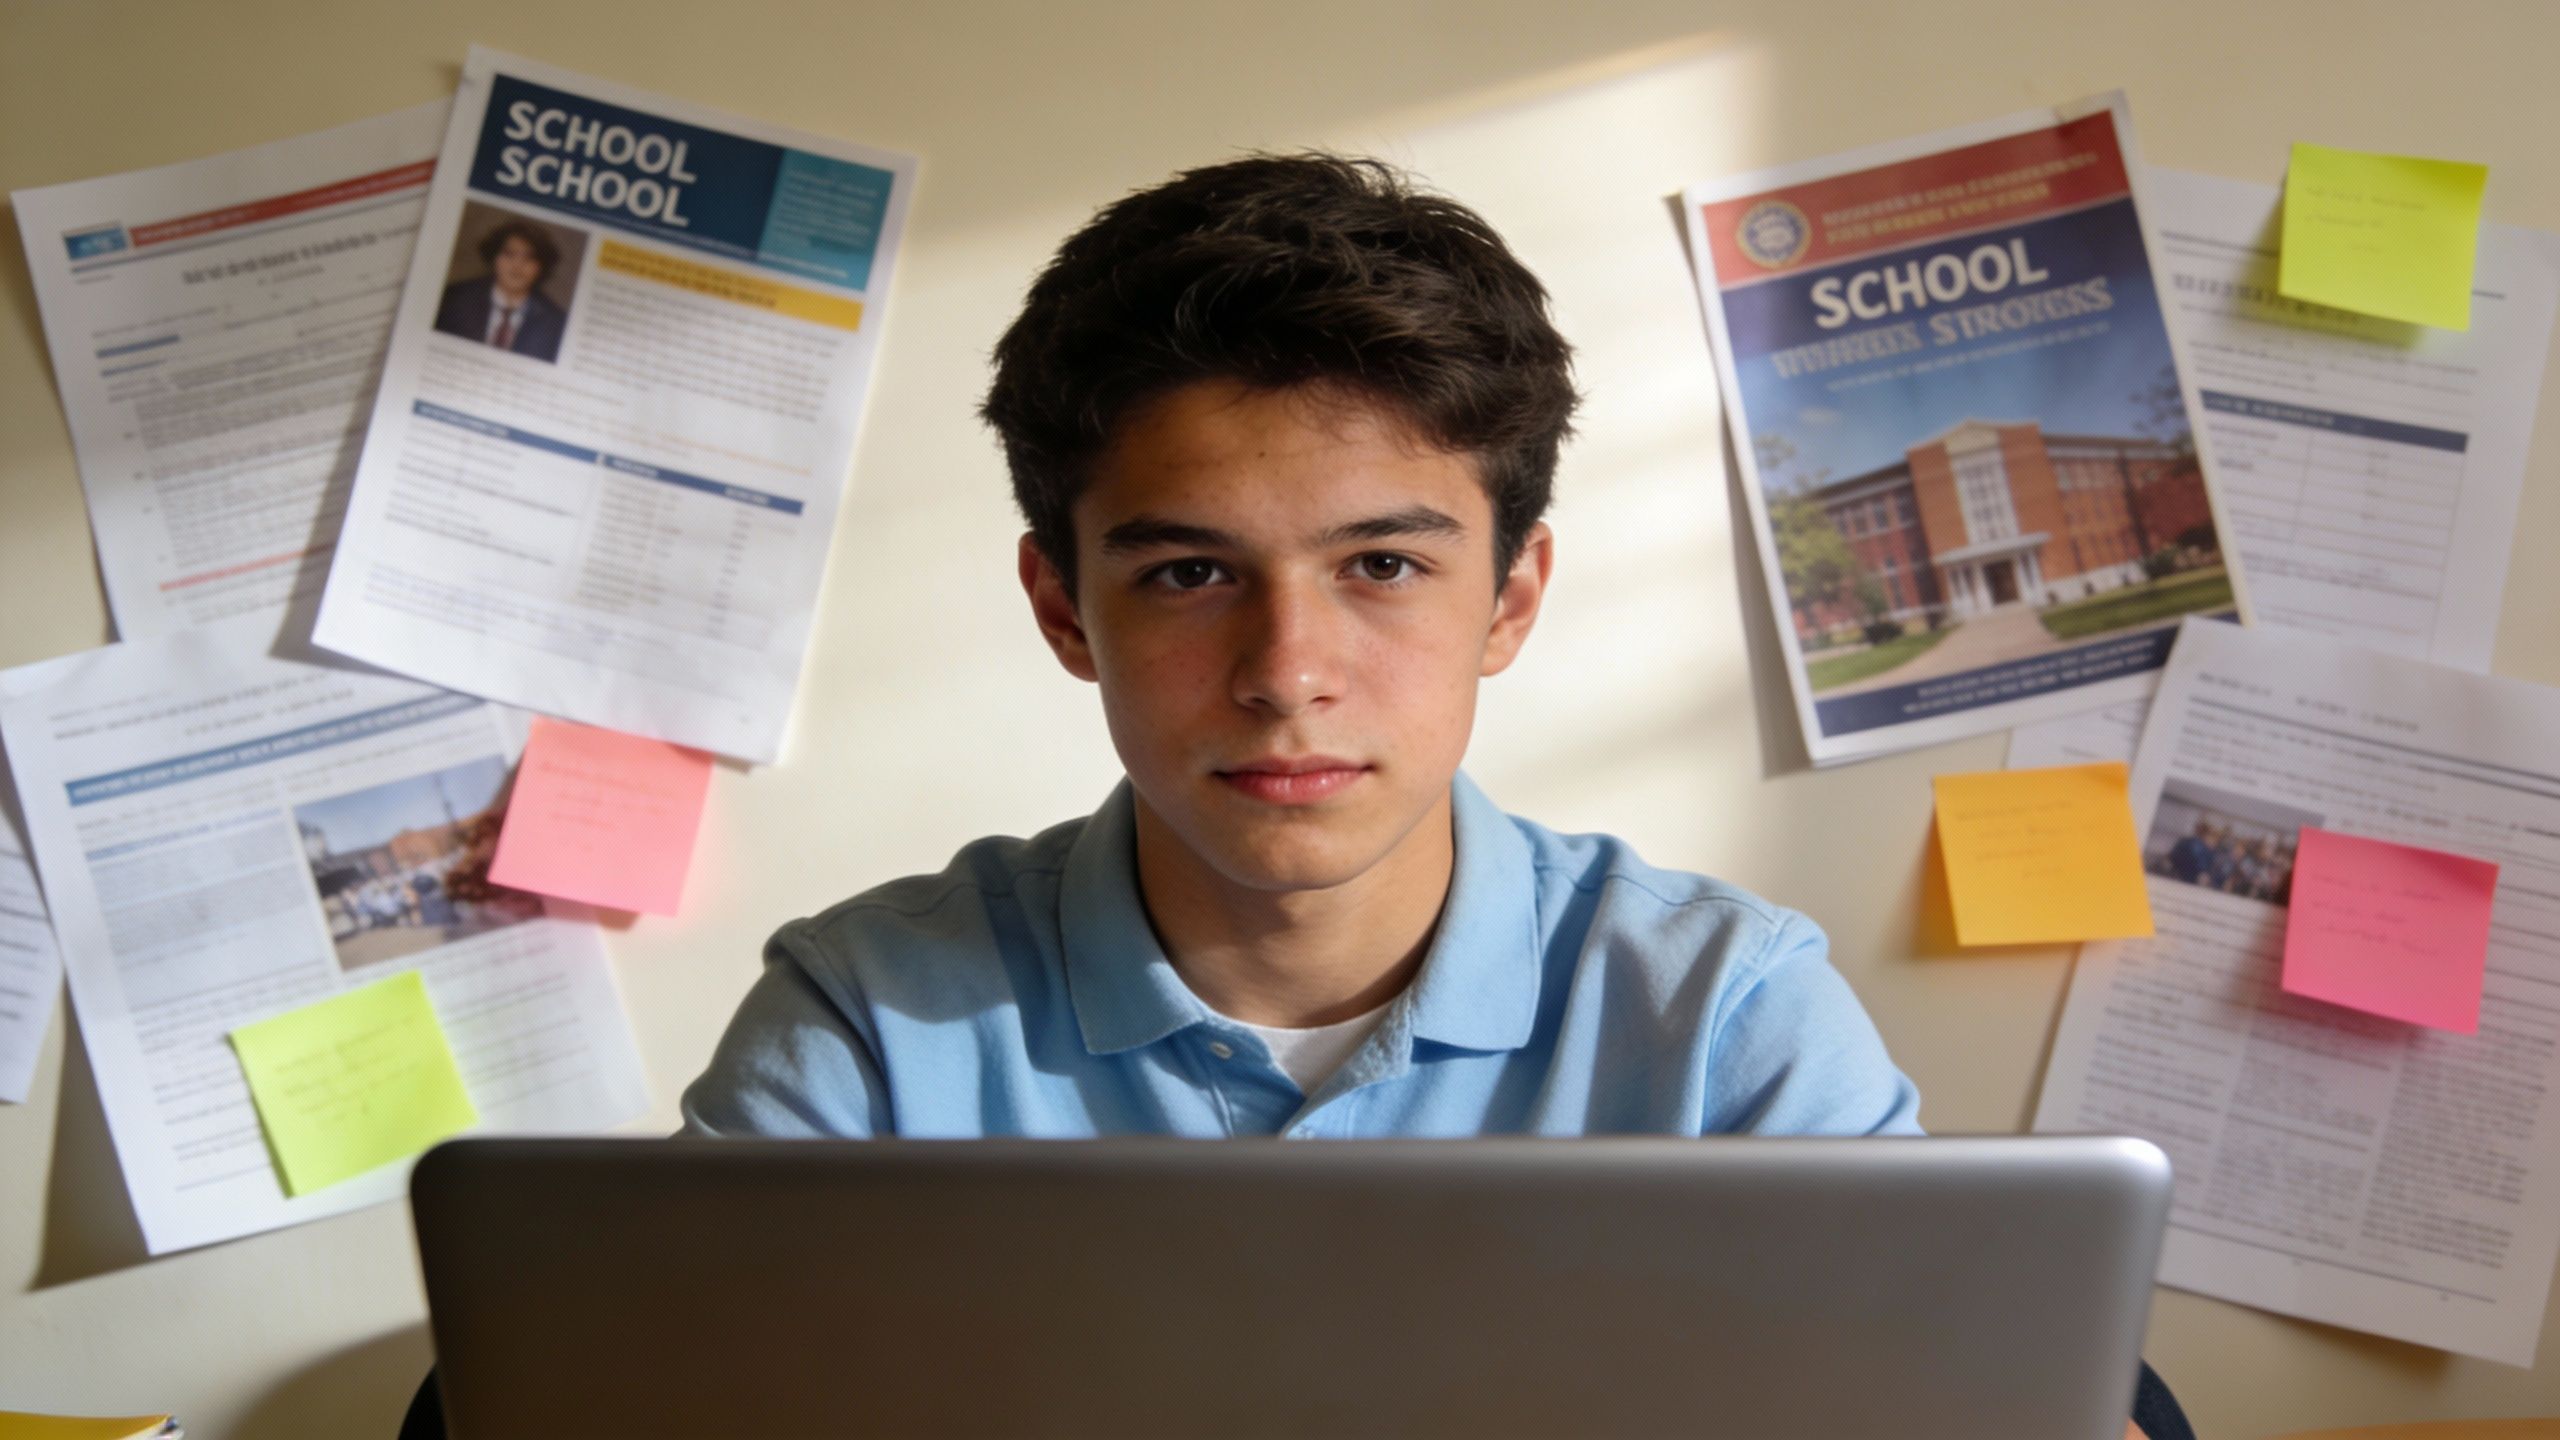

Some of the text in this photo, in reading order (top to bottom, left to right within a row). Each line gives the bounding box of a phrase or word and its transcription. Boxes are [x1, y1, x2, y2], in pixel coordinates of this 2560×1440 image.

[504, 100, 697, 184] SCHOOL
[495, 145, 689, 228] SCHOOL
[1810, 237, 2049, 330] SCHOOL
